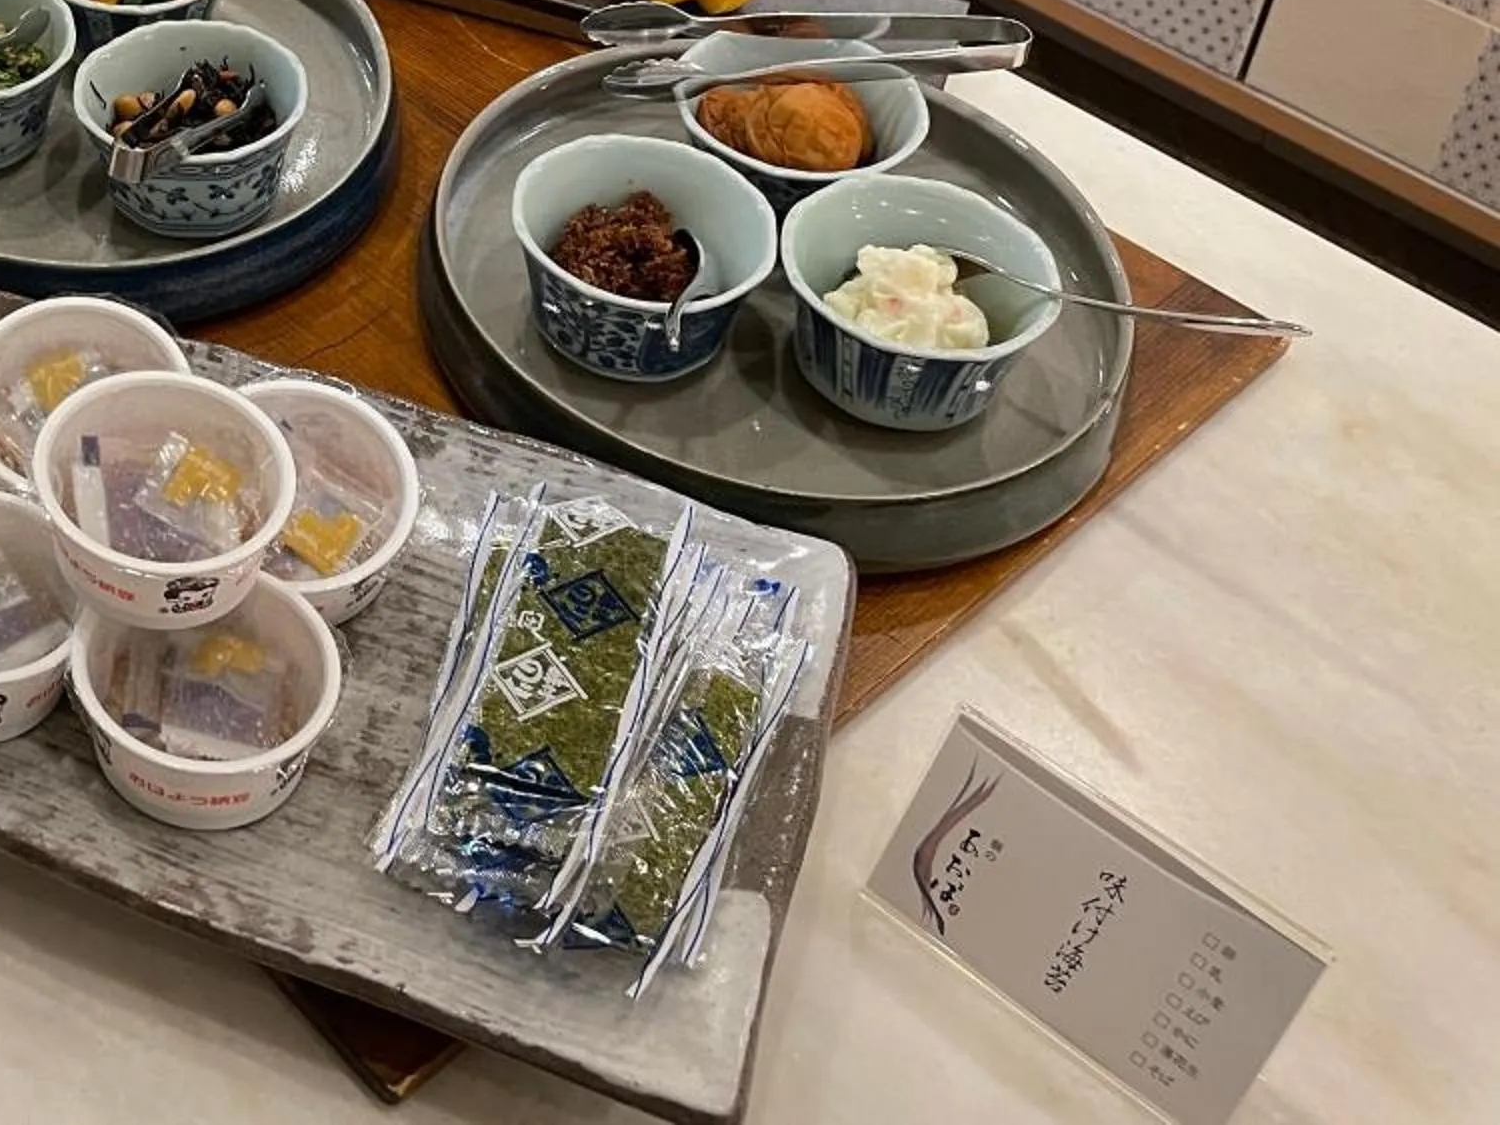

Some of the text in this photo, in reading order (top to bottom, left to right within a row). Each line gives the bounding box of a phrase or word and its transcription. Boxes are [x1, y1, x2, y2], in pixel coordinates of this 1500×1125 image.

[1043, 869, 1129, 994] 味付け海苔
